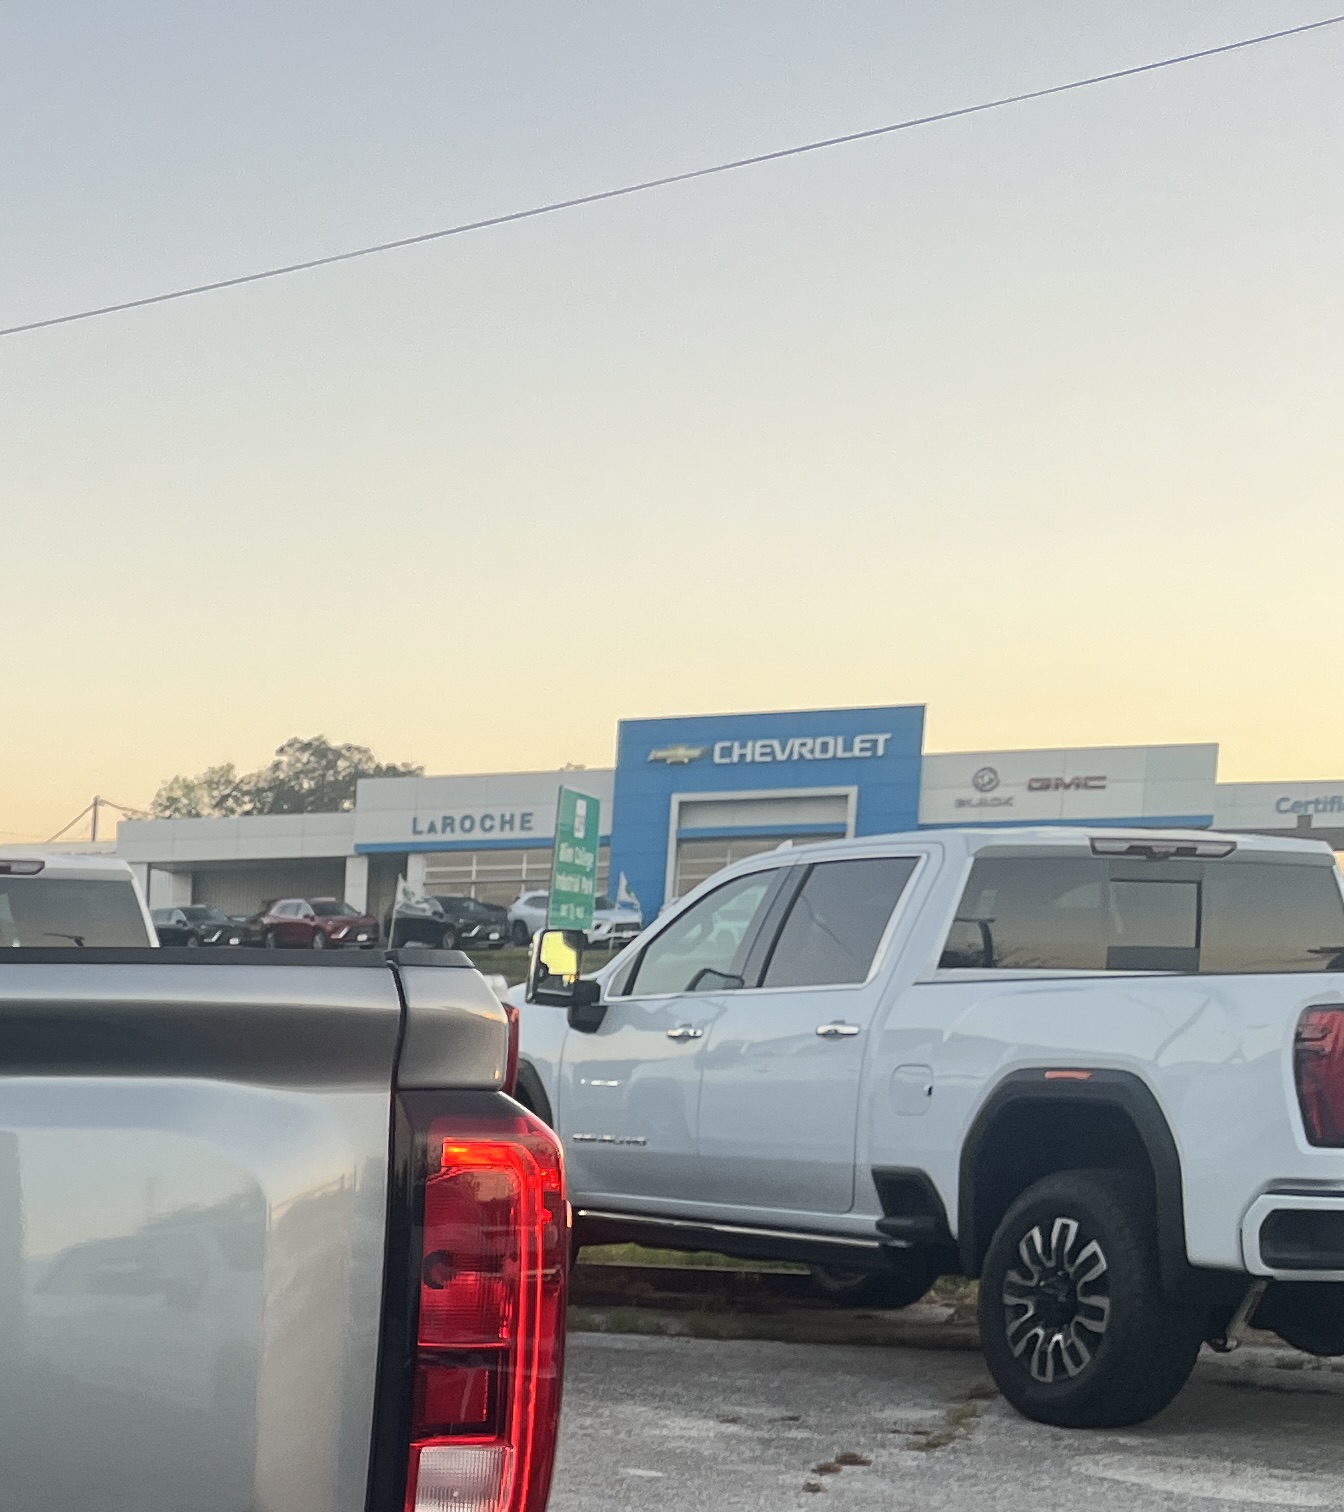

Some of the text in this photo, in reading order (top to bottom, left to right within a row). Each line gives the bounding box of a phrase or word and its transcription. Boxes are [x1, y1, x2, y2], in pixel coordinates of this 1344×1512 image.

[713, 732, 893, 765] CHEVROLET
[1027, 775, 1108, 792] GMC
[1275, 795, 1344, 815] Certifi
